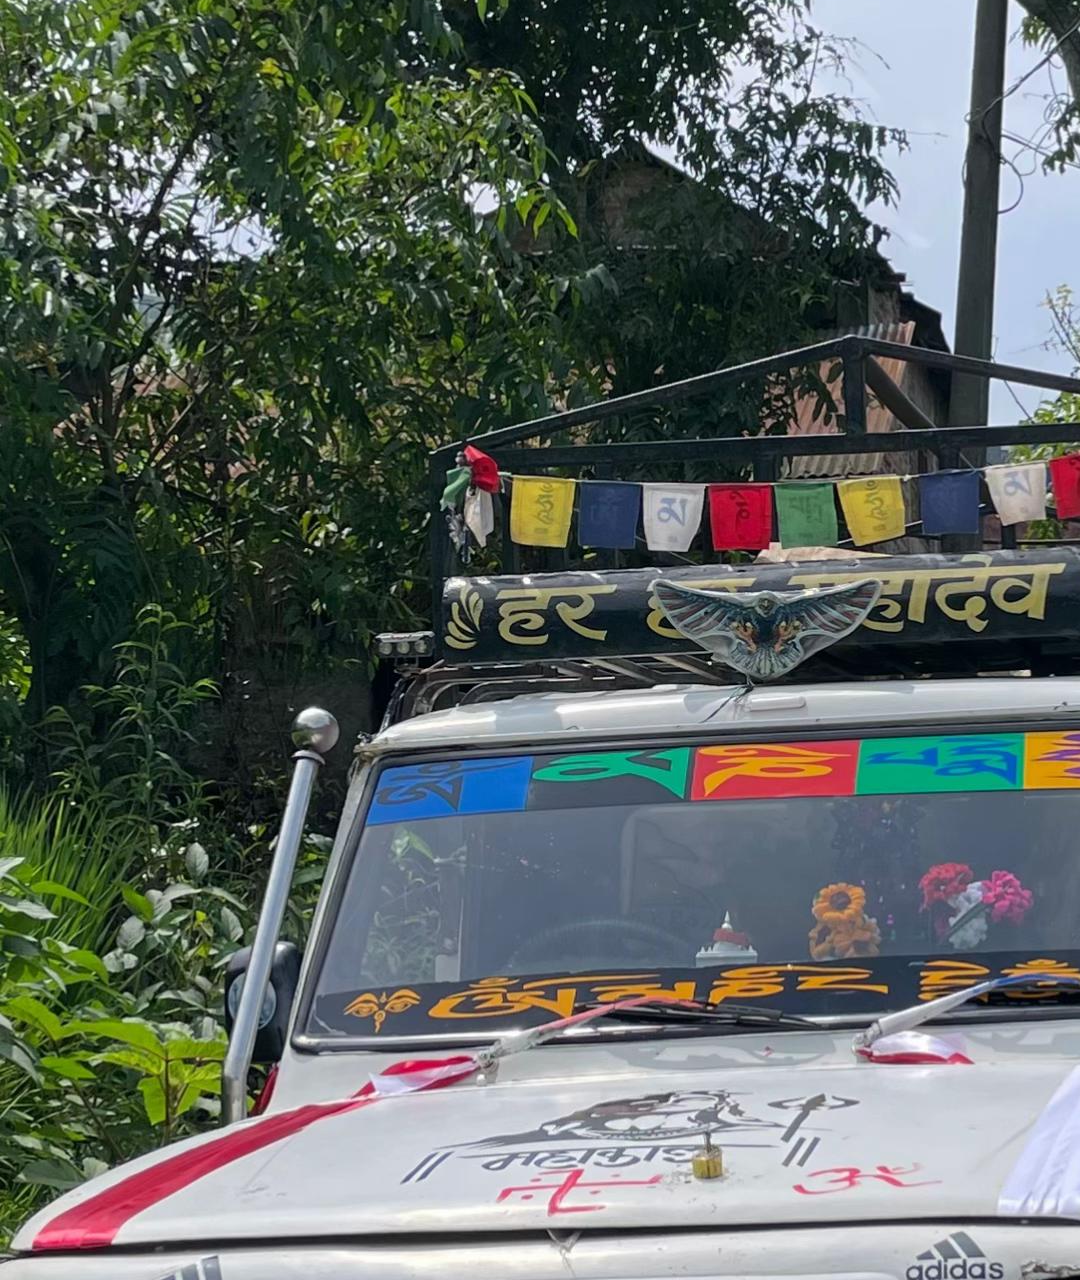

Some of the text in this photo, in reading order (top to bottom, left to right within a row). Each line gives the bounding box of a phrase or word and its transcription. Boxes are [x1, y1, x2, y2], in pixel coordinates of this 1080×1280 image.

[496, 584, 617, 645] हर
[788, 554, 1066, 632] हादेव
[905, 1258, 1004, 1280] adidas
